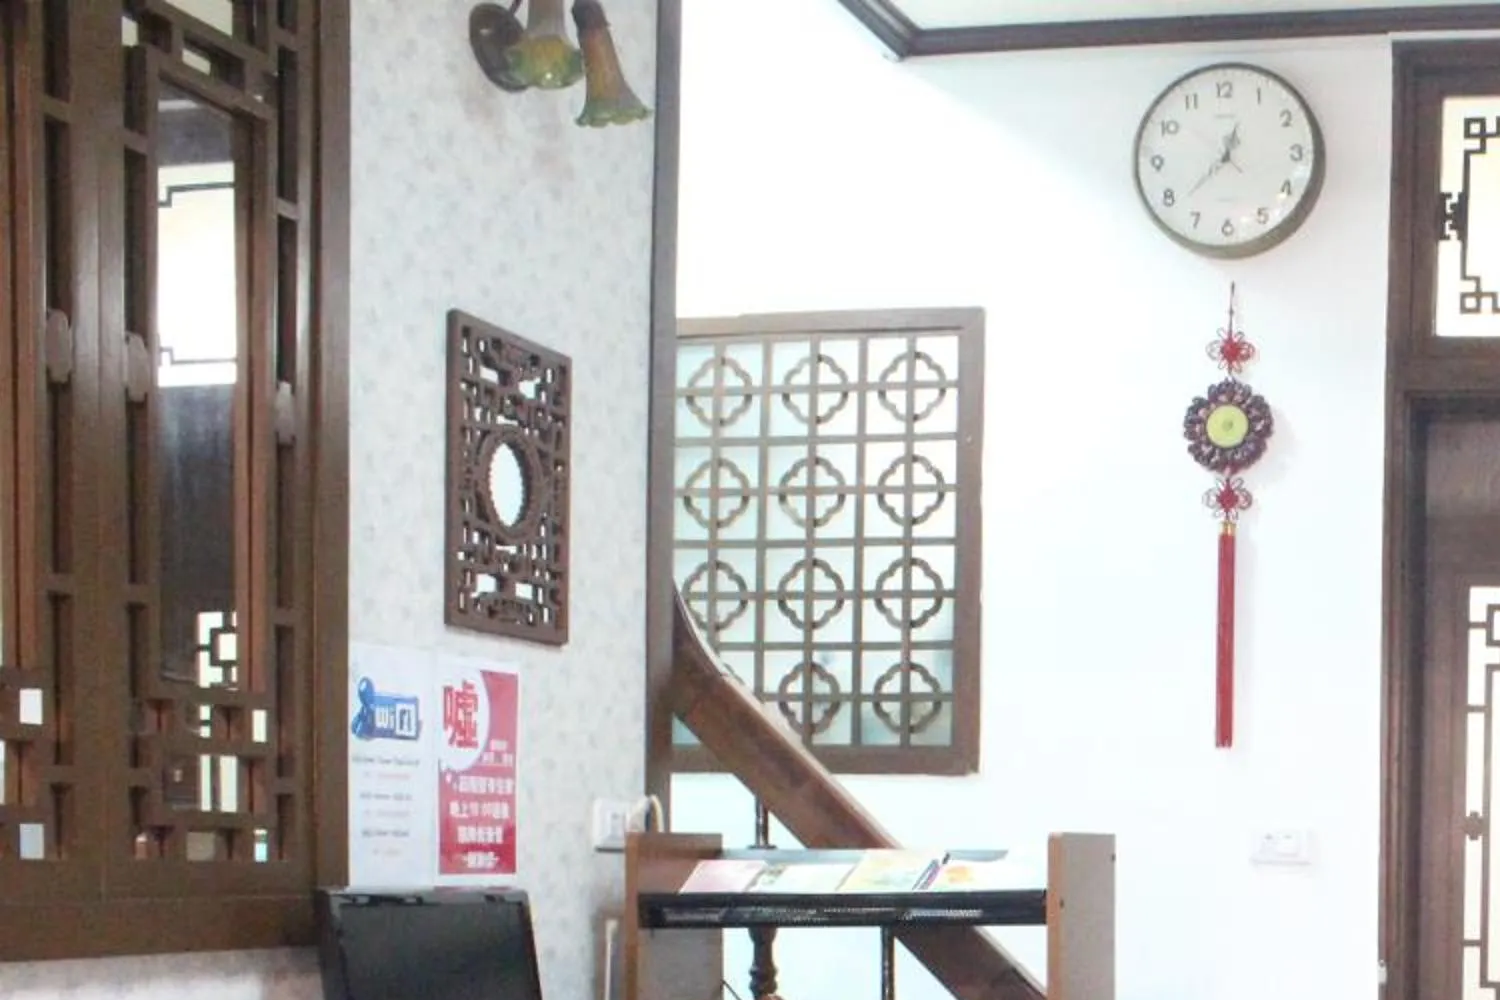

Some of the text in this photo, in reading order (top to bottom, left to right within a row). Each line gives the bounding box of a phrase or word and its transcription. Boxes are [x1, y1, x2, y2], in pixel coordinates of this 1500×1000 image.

[1216, 81, 1233, 98] 12
[1185, 93, 1199, 110] 11
[1161, 119, 1180, 136] 10
[1280, 110, 1292, 128] 2
[1290, 144, 1304, 162] 3
[1151, 154, 1164, 171] 9
[1281, 179, 1292, 196] 4
[1163, 188, 1176, 207] 8
[1190, 212, 1202, 229] 7
[1256, 208, 1270, 226] 5
[1221, 218, 1235, 236] 6
